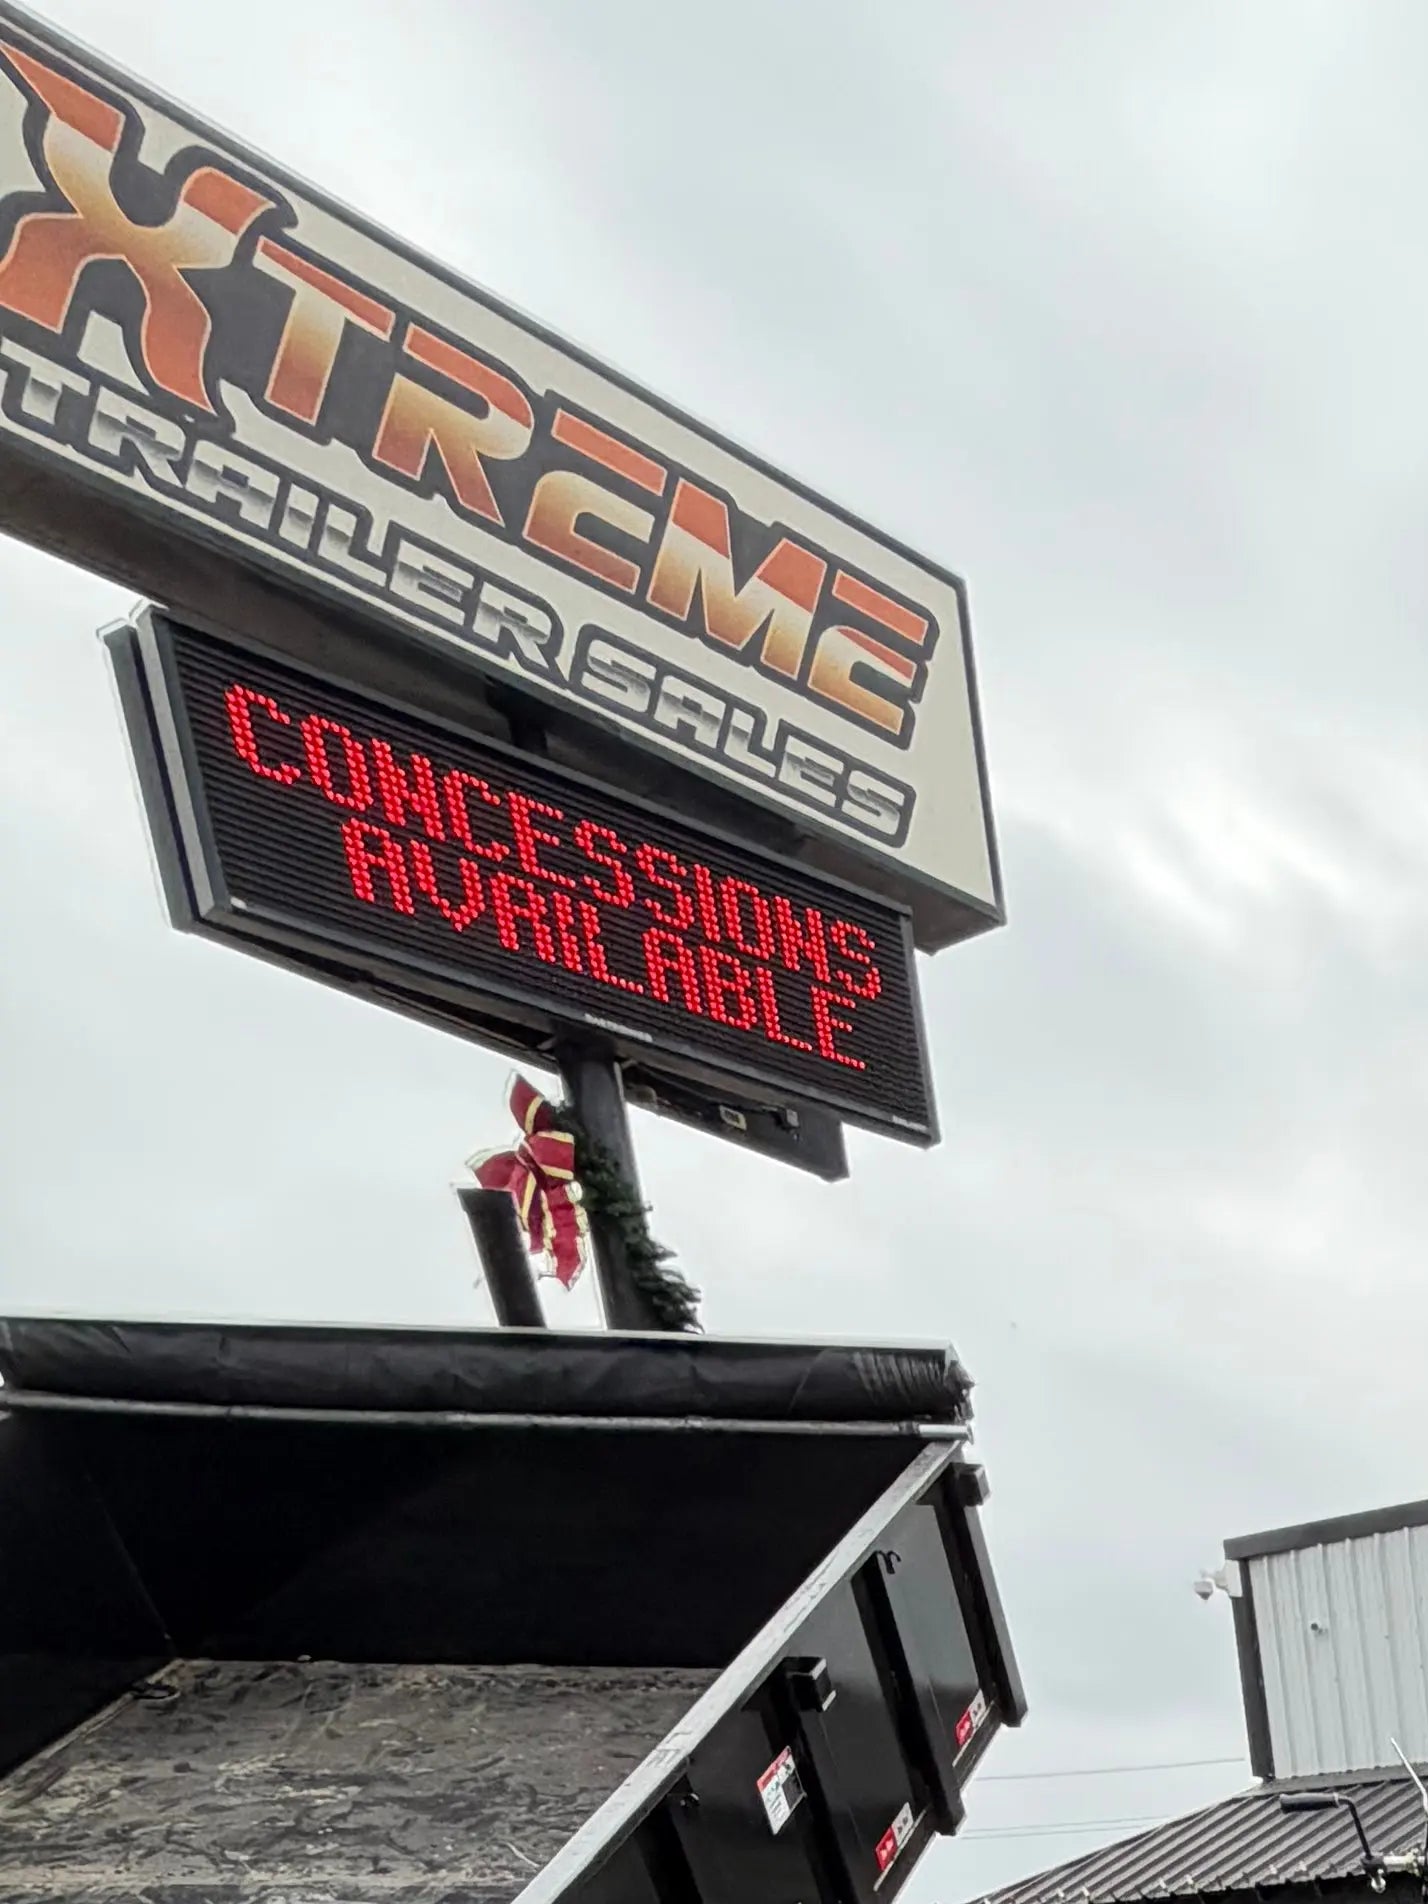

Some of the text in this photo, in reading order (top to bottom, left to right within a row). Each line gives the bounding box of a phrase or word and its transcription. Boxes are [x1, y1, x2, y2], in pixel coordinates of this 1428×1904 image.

[0, 40, 929, 735] XTREME
[0, 337, 904, 836] TRAILER SALES
[224, 683, 882, 1000] CONCESSIONS
[341, 817, 866, 1070] AVAILABLE
